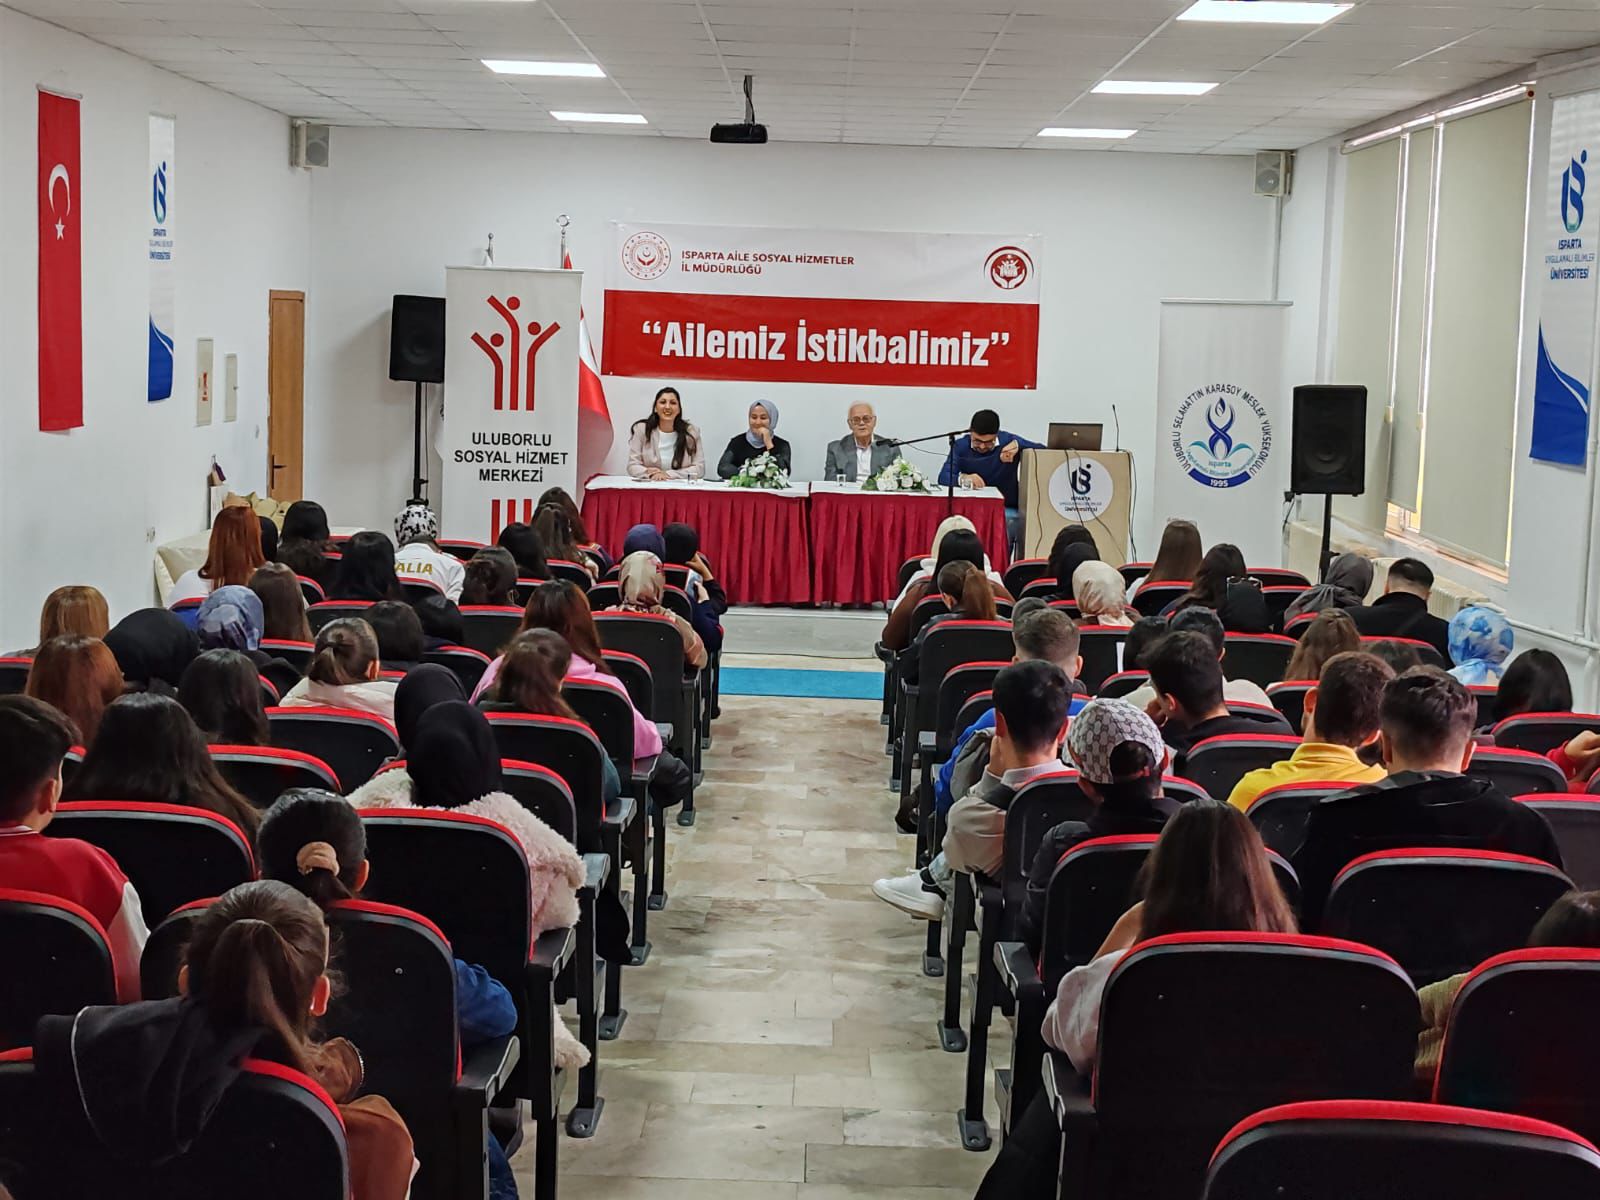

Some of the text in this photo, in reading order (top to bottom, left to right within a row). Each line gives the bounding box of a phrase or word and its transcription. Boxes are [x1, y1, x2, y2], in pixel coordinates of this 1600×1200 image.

[1558, 238, 1582, 249] ISPARTA
[681, 249, 855, 266] ISPARTA AİLE SOSYAL HİZMETLER
[681, 261, 762, 275] İL MÜDÜRLÜĞÜ
[1172, 431, 1192, 472] ULUBORLU
[1204, 383, 1242, 397] KARASOY
[1241, 391, 1267, 418] MESLEK
[472, 432, 552, 446] ULUBORLU
[454, 448, 568, 465] SOSYAL HİZMET
[479, 467, 543, 482] MERKEZİ
[1210, 479, 1229, 487] 1995
